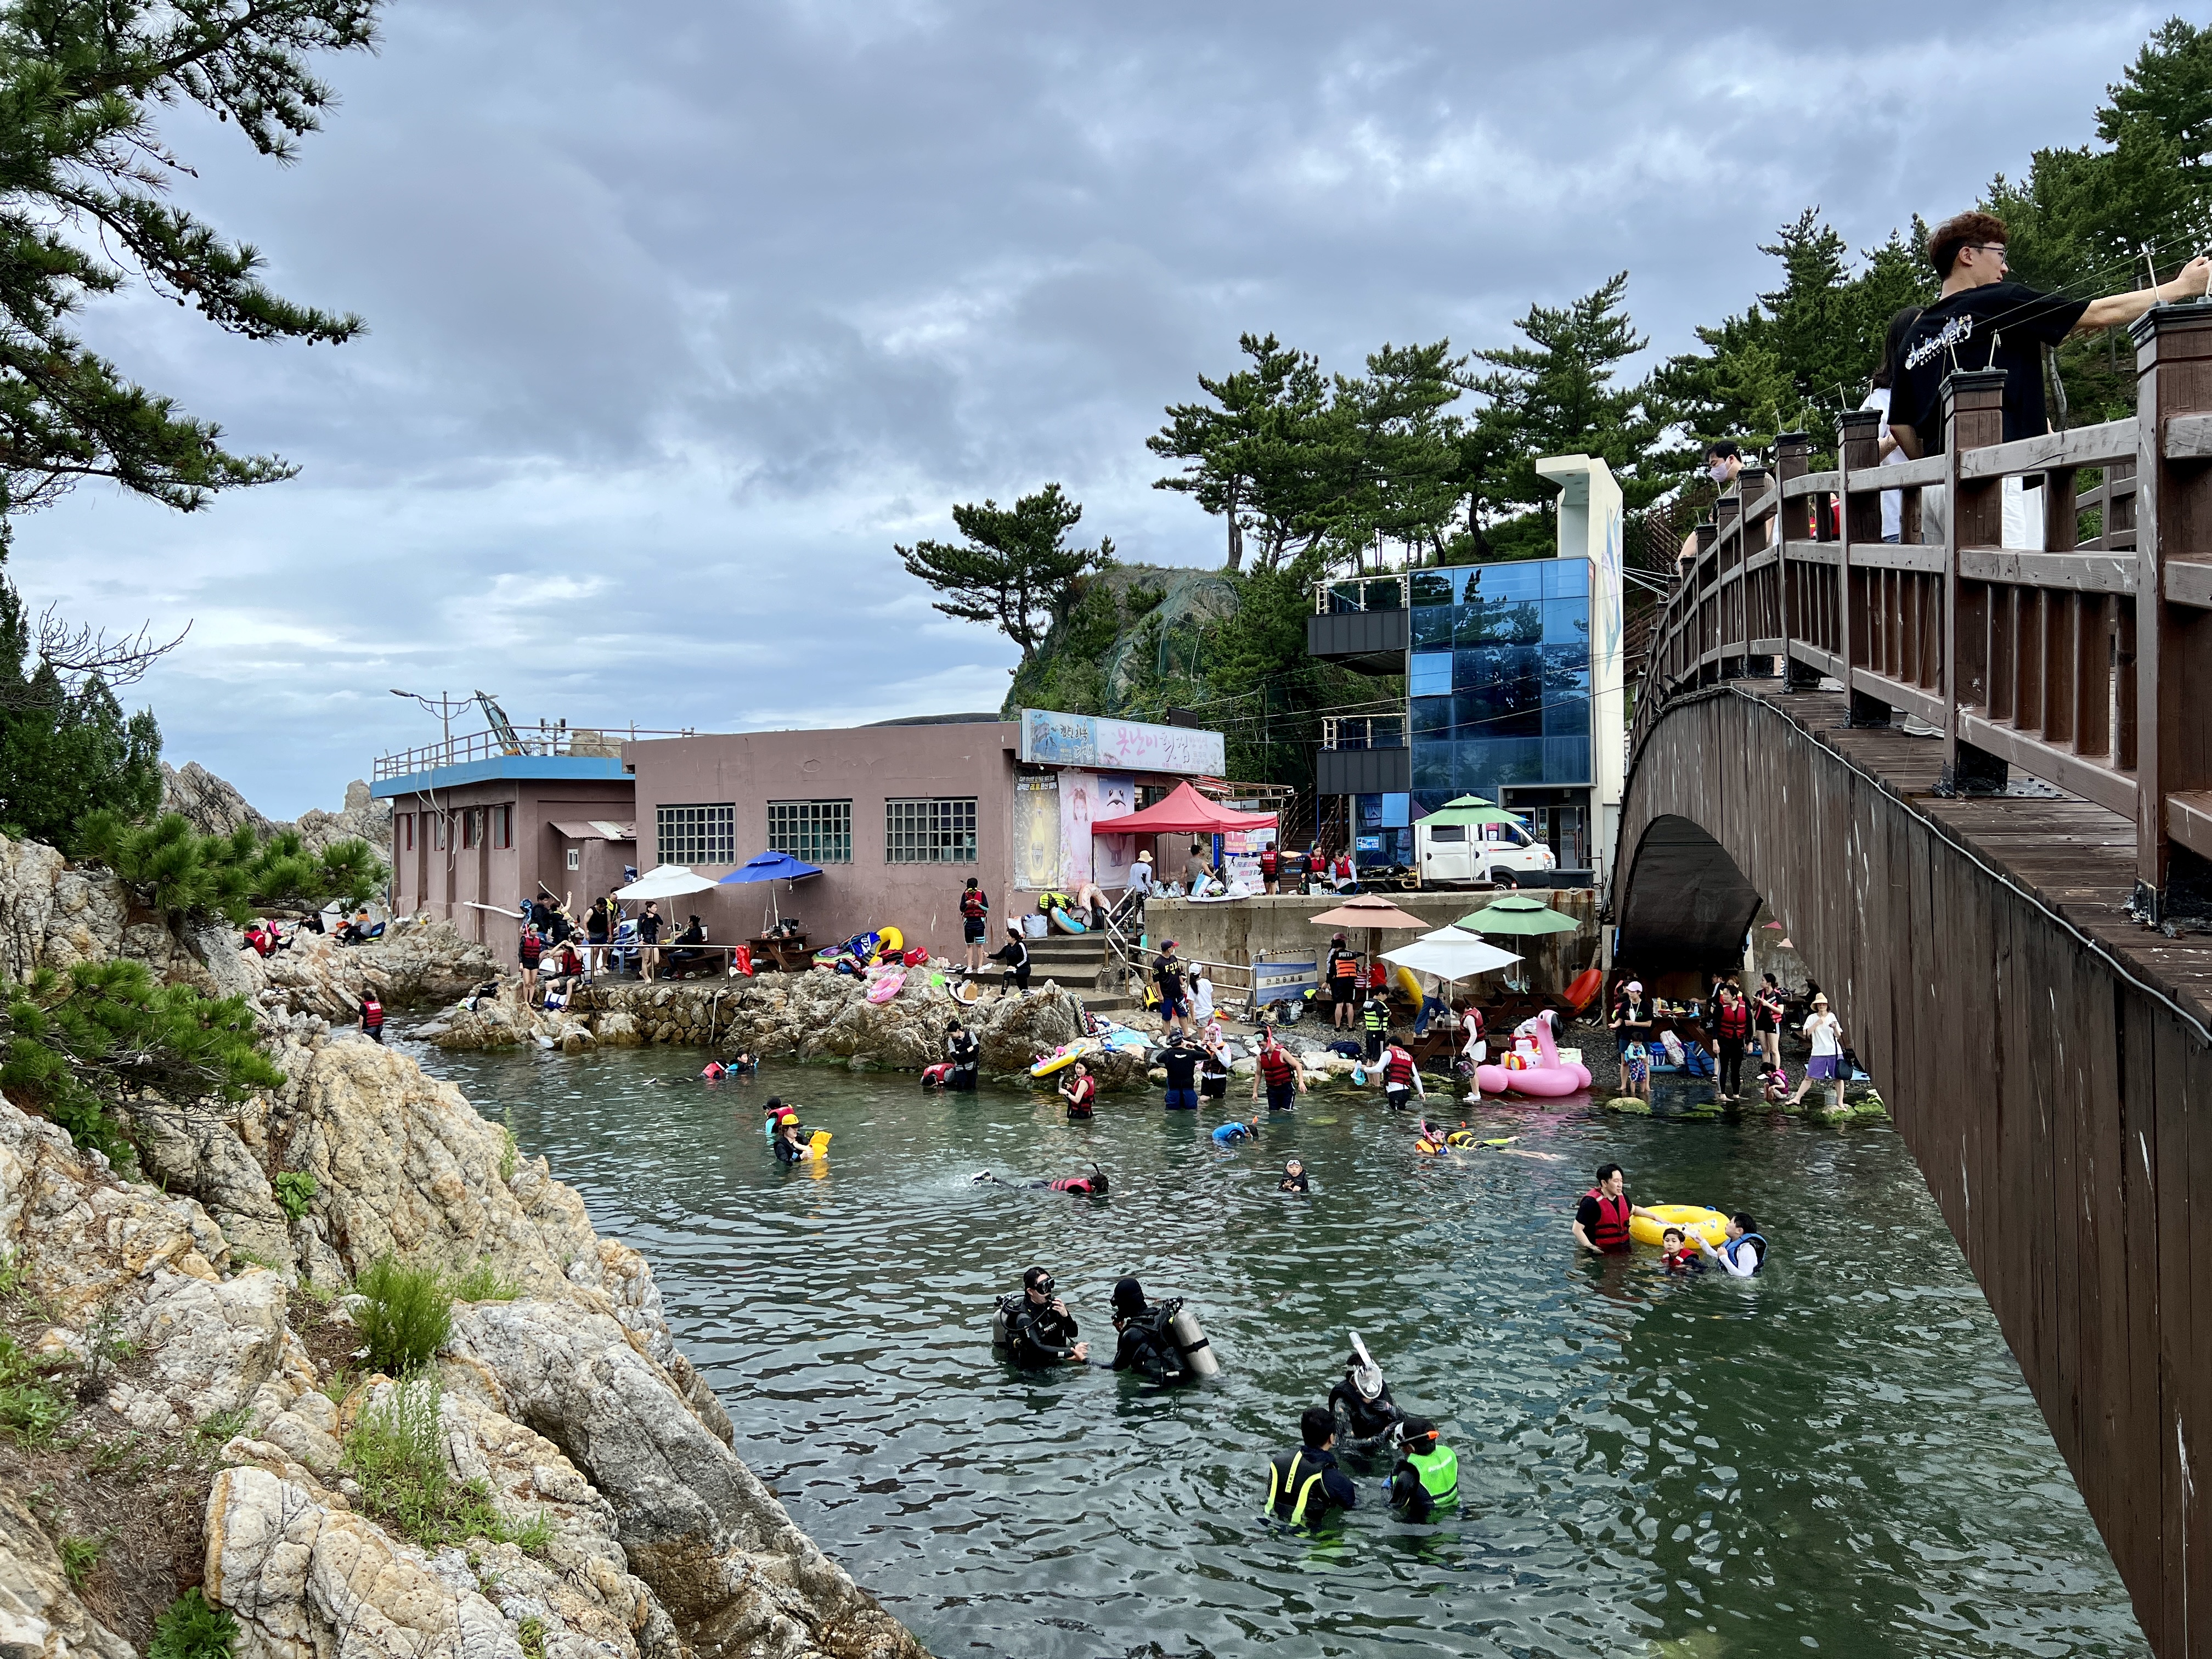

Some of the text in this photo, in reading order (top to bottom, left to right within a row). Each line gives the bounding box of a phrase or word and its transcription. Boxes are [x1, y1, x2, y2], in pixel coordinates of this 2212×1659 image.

[1905, 320, 1973, 370] Discovery
[1920, 338, 1964, 366] EXPEDIN
[1116, 727, 1158, 756] 못난이
[1165, 962, 1178, 973] FOX
